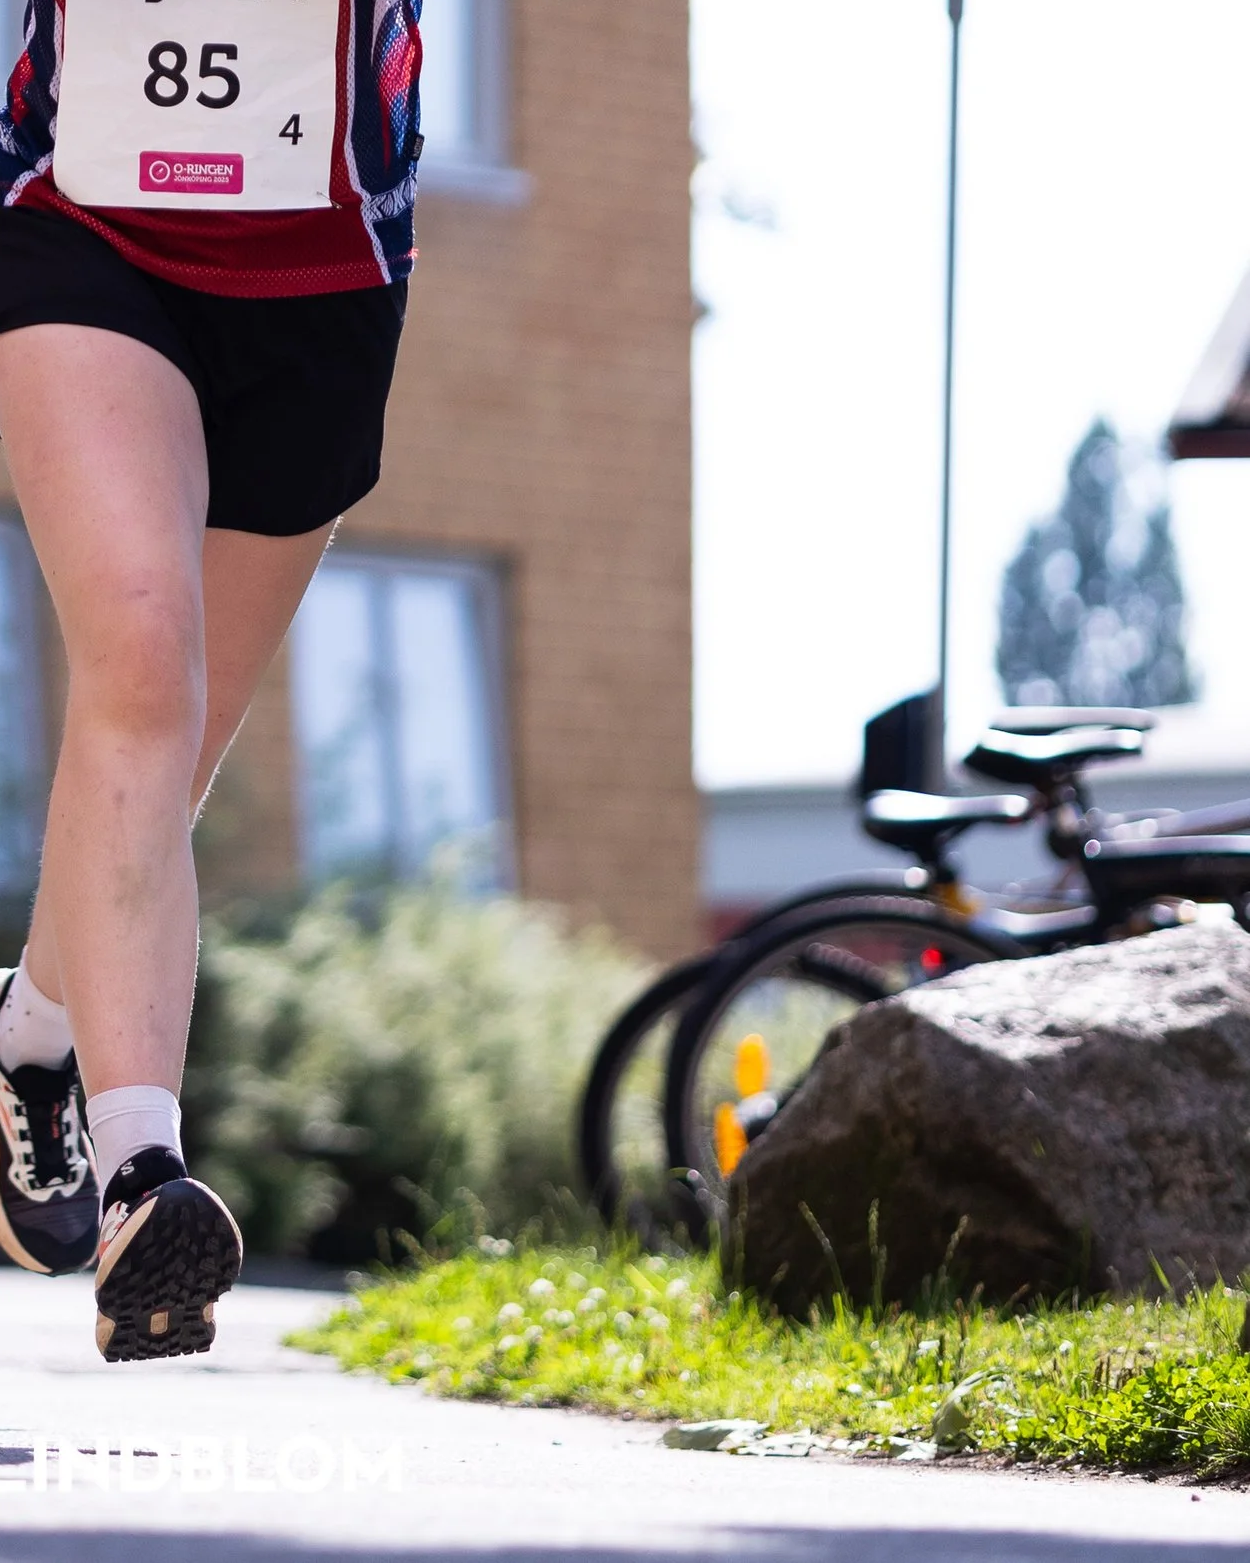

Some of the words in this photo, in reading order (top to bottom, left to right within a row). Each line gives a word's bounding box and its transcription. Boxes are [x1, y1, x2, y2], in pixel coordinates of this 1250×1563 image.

[143, 40, 241, 110] 85
[279, 114, 304, 146] 4
[173, 163, 234, 176] O-RINGEN
